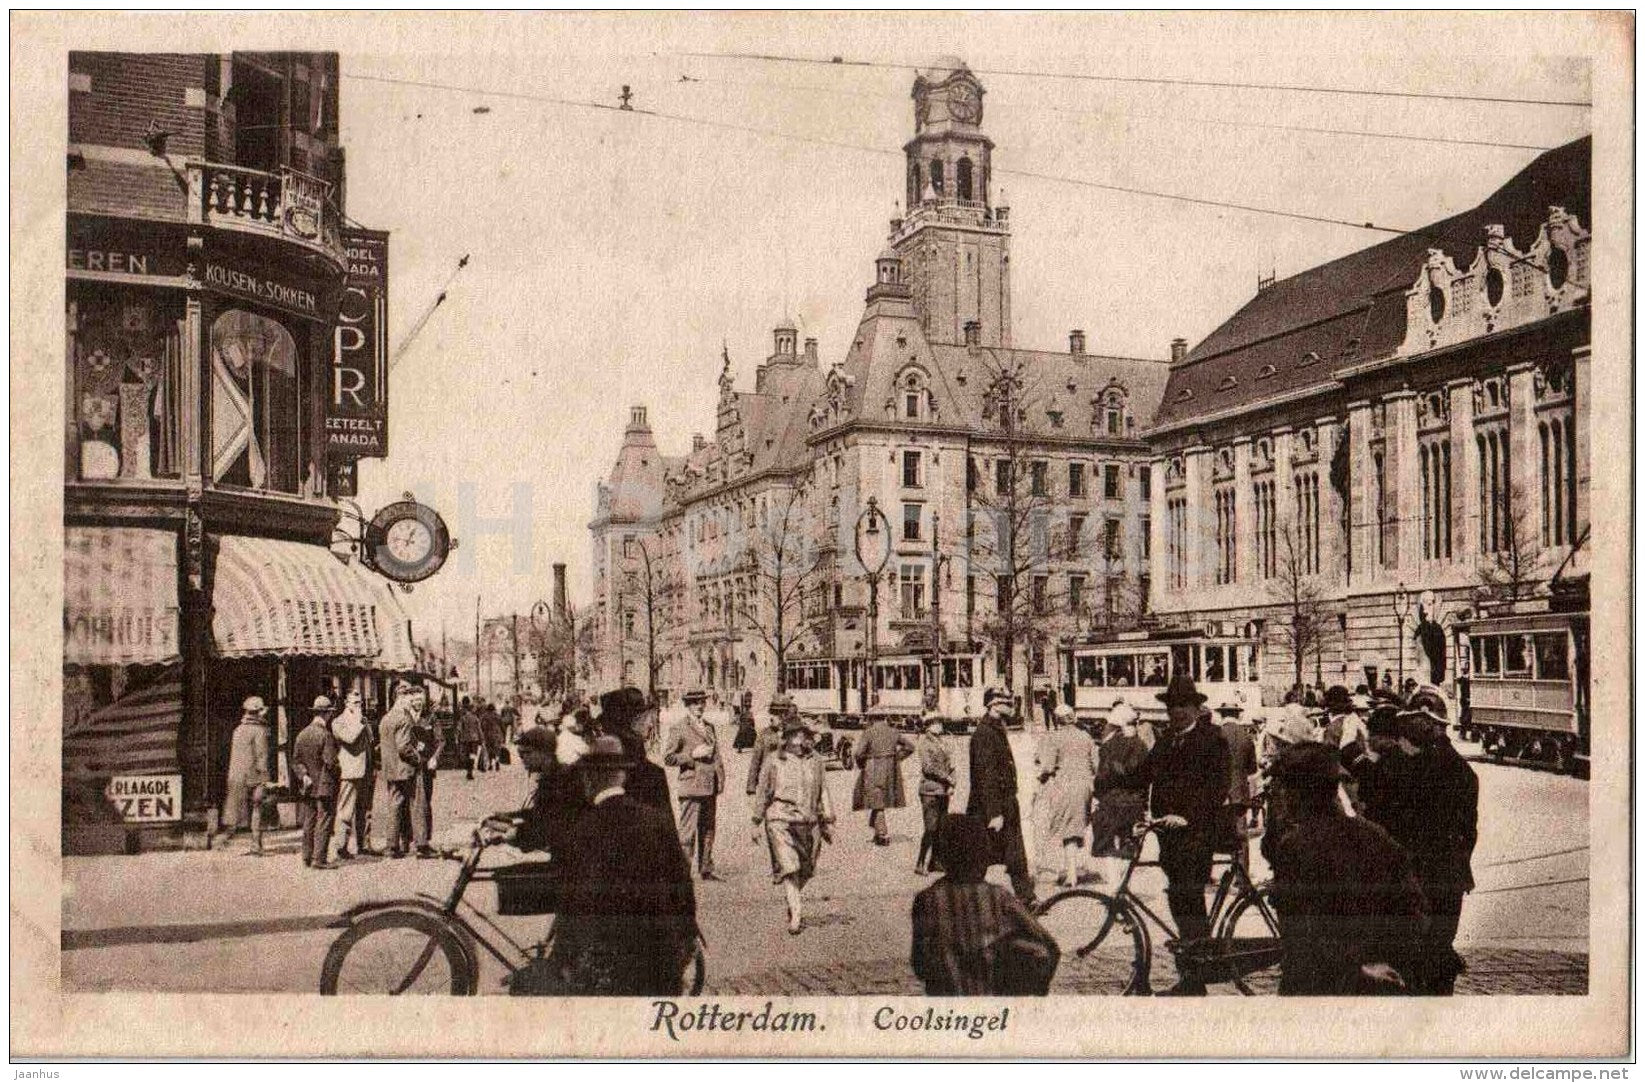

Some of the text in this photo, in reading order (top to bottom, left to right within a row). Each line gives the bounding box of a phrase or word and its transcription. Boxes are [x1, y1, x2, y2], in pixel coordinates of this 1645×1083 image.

[68, 249, 147, 274] EREN
[206, 263, 257, 293] KOUSEN
[265, 281, 315, 311] SOKKEN
[120, 798, 173, 817] ZEN
